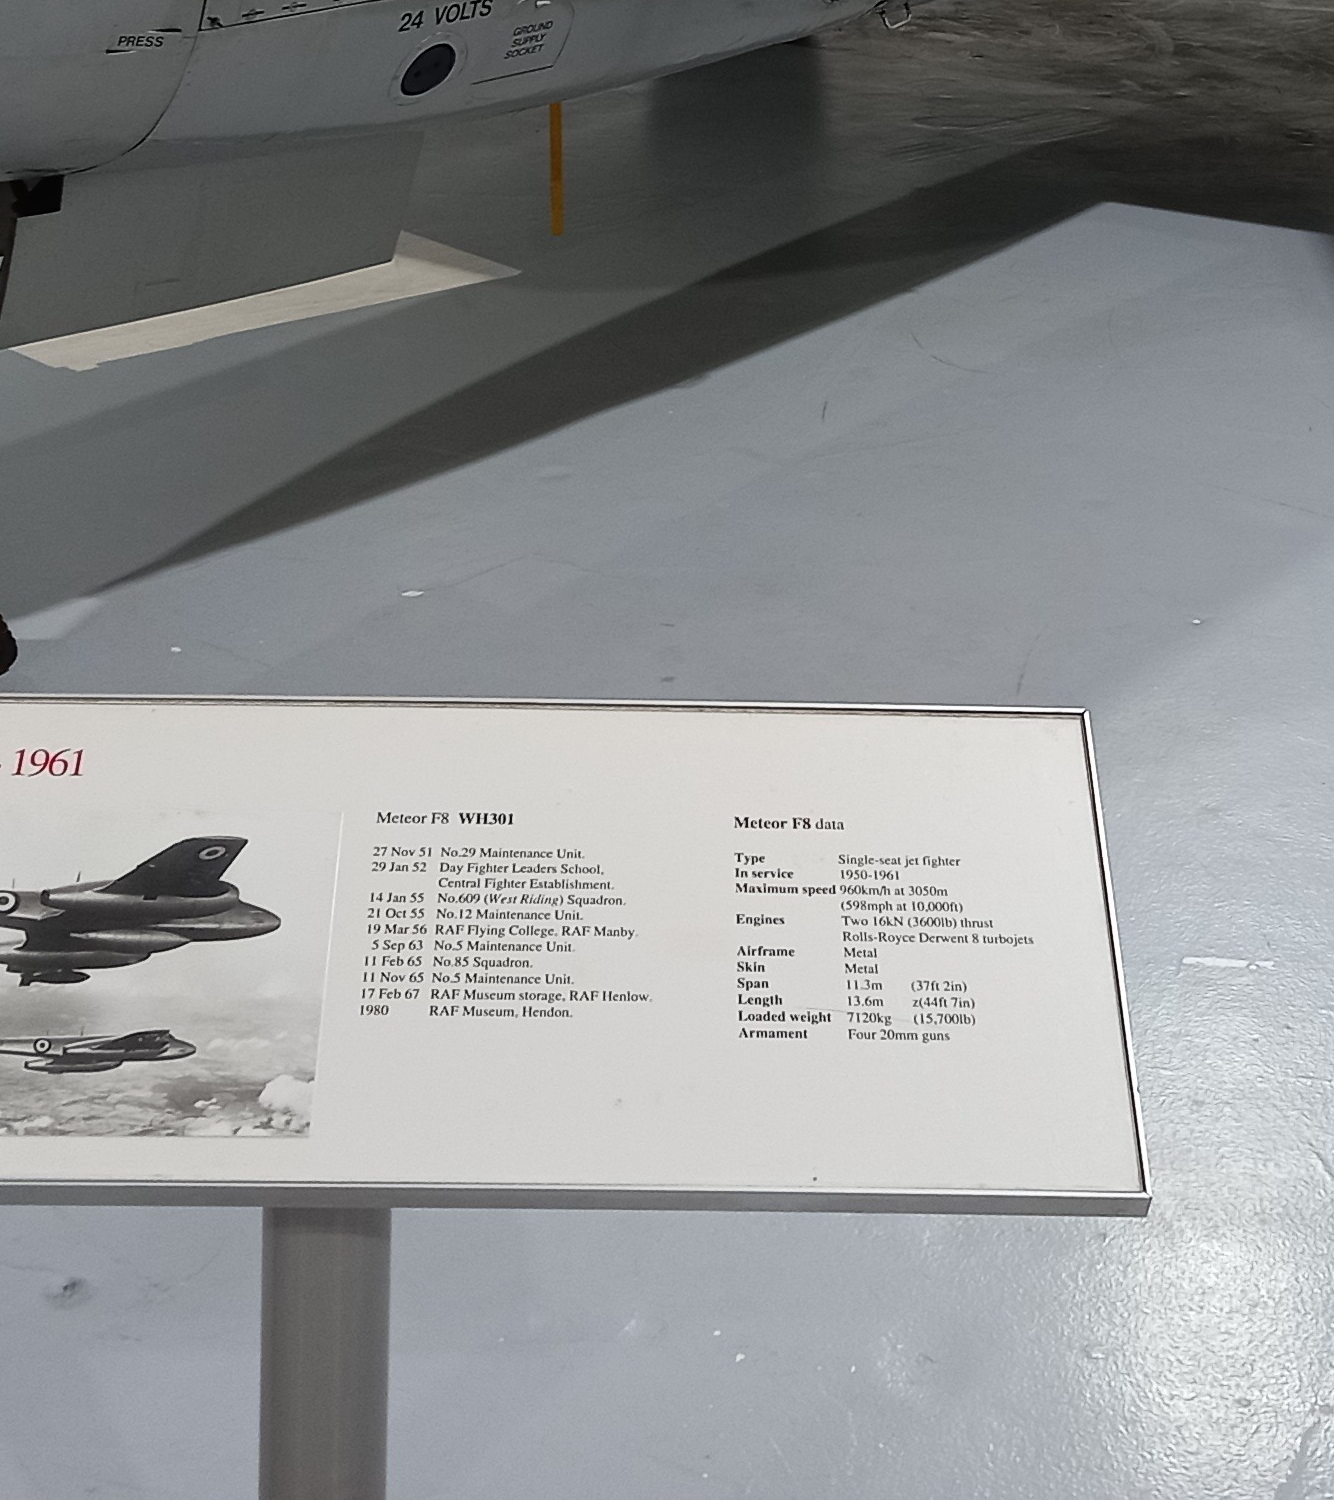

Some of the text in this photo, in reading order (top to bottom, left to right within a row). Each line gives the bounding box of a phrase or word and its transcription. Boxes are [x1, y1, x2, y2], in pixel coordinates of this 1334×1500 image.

[398, 10, 424, 32] 24
[513, 21, 553, 36] GROUND
[117, 36, 164, 47] PRESS
[511, 32, 546, 47] SUPPLY
[504, 44, 545, 59] SOCKET
[376, 812, 513, 825] Meteor F8 WH301
[734, 816, 844, 830] Meteor F8 data
[373, 846, 584, 859] 27 Nov 51 No.29 Maintenance Unit.
[734, 852, 960, 868] Type Single-seat jet fighter
[371, 861, 386, 872] 29
[389, 861, 409, 872] Jan
[411, 861, 426, 872] 52
[439, 862, 463, 875] Day
[467, 862, 509, 875] Fighter
[511, 862, 557, 873] Leaders
[735, 867, 899, 880] In service 1950-1961
[735, 882, 948, 897] Maximum speed 960km/h at 3050m
[370, 892, 626, 908] 14 Jan 55 No.609 (West Riding) Squadron.
[367, 923, 381, 934] 19
[384, 923, 410, 934] Mar
[411, 924, 427, 934] 56
[435, 924, 464, 935] RAF
[467, 924, 505, 938] Flying
[561, 925, 591, 936] RAF
[842, 930, 1034, 947] Rolls-Royce Derwent 8 turbojets
[364, 955, 376, 966] 11
[381, 955, 403, 966] Feb
[407, 956, 422, 967] 65
[472, 956, 533, 970] Squadron.
[737, 977, 769, 991] Span
[911, 980, 940, 992] (37ft
[943, 980, 967, 993] 2in)
[361, 988, 375, 999] 17
[378, 988, 401, 999] Feb
[404, 988, 420, 999] 67
[430, 988, 460, 1000] RAF
[463, 988, 515, 1000] Museum
[569, 990, 599, 1001] RAF
[738, 994, 975, 1009] Length 13.6m z(44ft 7in)
[360, 1004, 389, 1015] 1980
[429, 1005, 459, 1016] RAF
[522, 1006, 572, 1017] Hendon.
[738, 1010, 785, 1022] Loaded
[789, 1011, 831, 1025] weight
[846, 1012, 892, 1026] 7120kg
[739, 1027, 950, 1043] Armament Four 20mm guns
